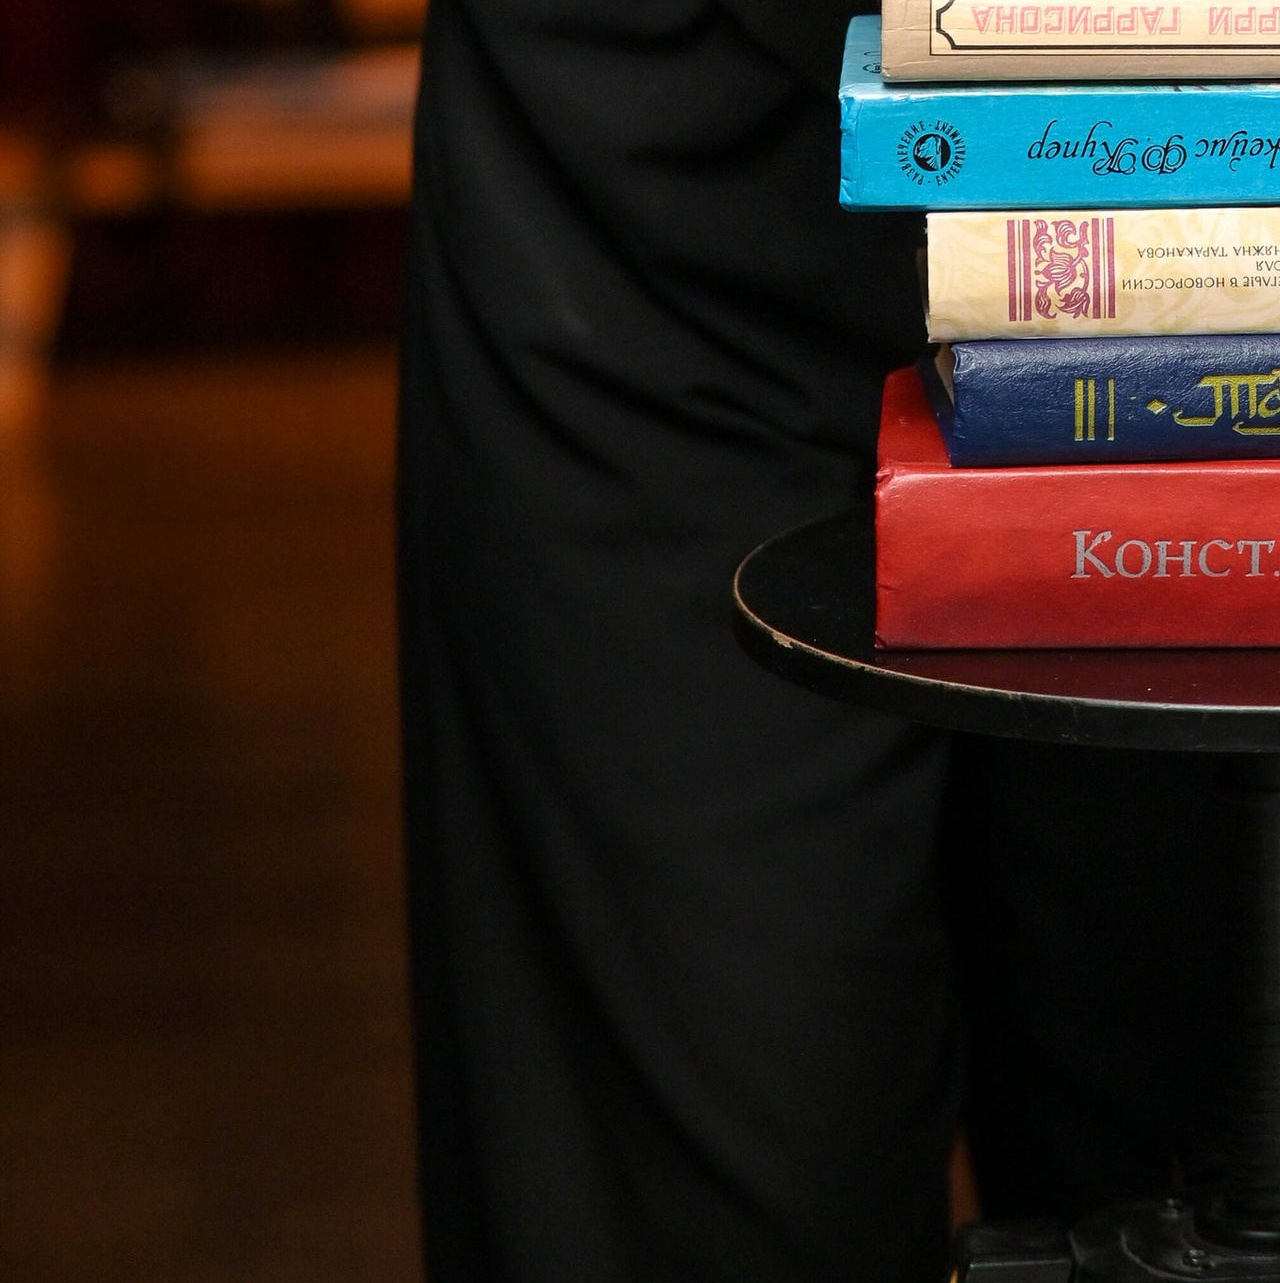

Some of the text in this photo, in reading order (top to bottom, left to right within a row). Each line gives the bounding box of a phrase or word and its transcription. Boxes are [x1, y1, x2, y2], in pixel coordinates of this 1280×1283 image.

[970, 5, 1182, 36] ГАРРИСОНА
[897, 120, 926, 186] РАЗВЛЕЧЕНИЕ
[1027, 119, 1139, 176] Купер
[1136, 245, 1228, 258] ТАРАКАНОВА
[1121, 276, 1225, 290] НОВОРОССИИ
